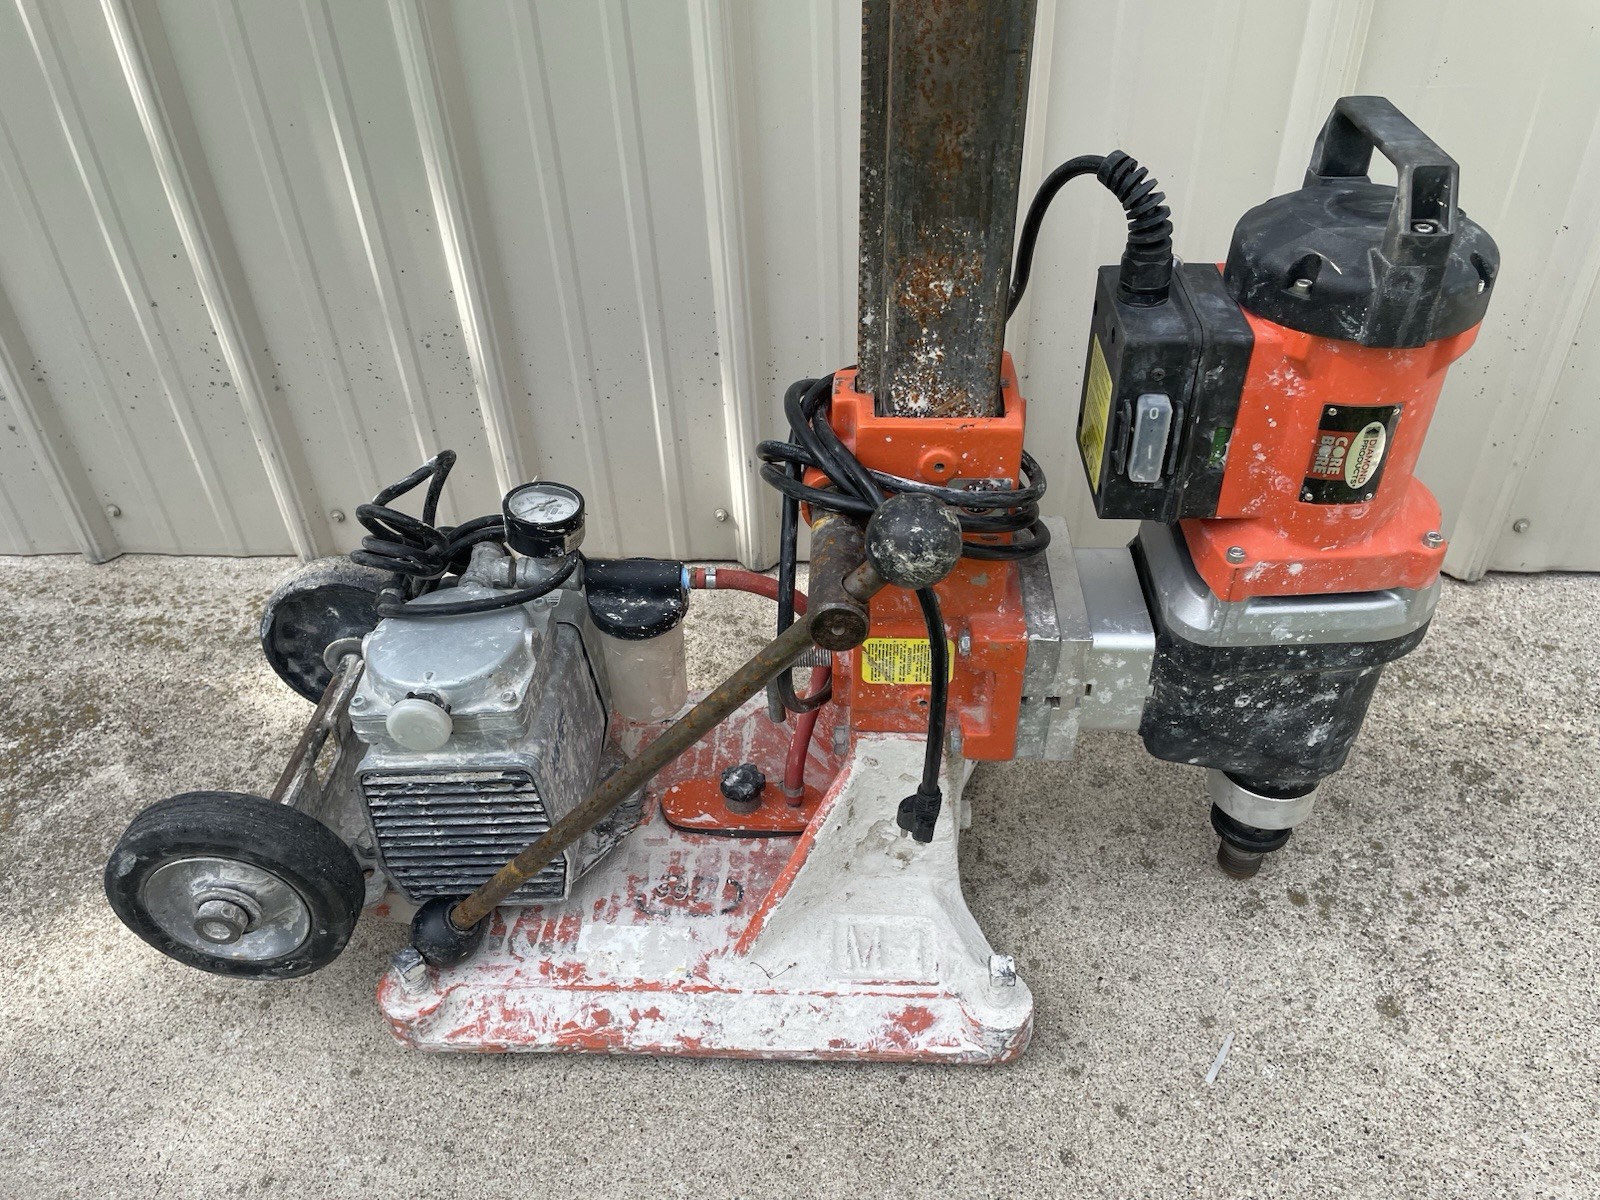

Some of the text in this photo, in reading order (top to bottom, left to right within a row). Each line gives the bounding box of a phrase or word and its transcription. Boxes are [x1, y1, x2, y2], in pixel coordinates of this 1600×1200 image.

[1313, 436, 1335, 473] BORE
[1327, 437, 1348, 474] CORE
[1351, 440, 1368, 484] PRODUCTS
[1358, 440, 1376, 483] DIAMOND
